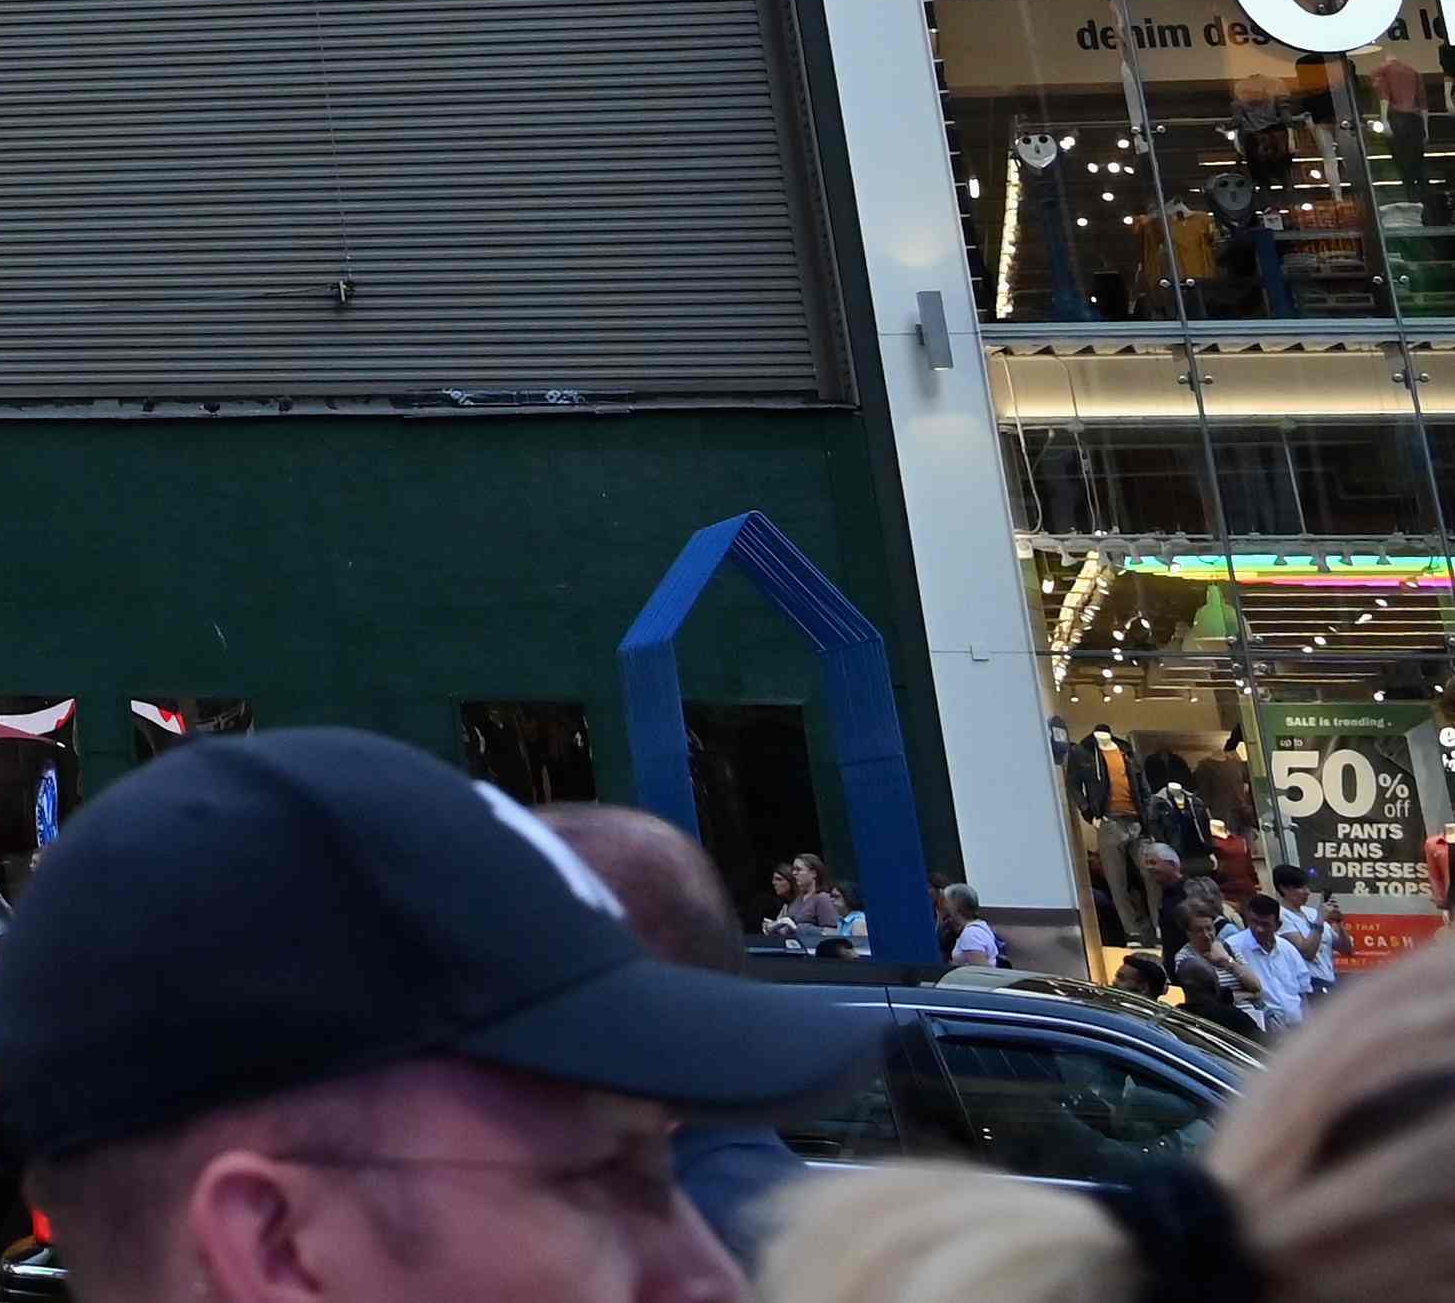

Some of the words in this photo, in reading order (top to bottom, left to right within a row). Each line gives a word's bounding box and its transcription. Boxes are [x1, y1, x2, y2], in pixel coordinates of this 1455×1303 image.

[1077, 16, 1192, 51] denim
[1286, 716, 1317, 727] SALE
[1319, 716, 1331, 727] is
[1333, 717, 1384, 729] trending
[1384, 799, 1412, 819] off
[1337, 823, 1404, 840] PANTS
[1314, 842, 1384, 859] JEANS
[1331, 861, 1430, 879] DRESSES
[1353, 880, 1371, 895] &
[1375, 880, 1434, 896] TOPS
